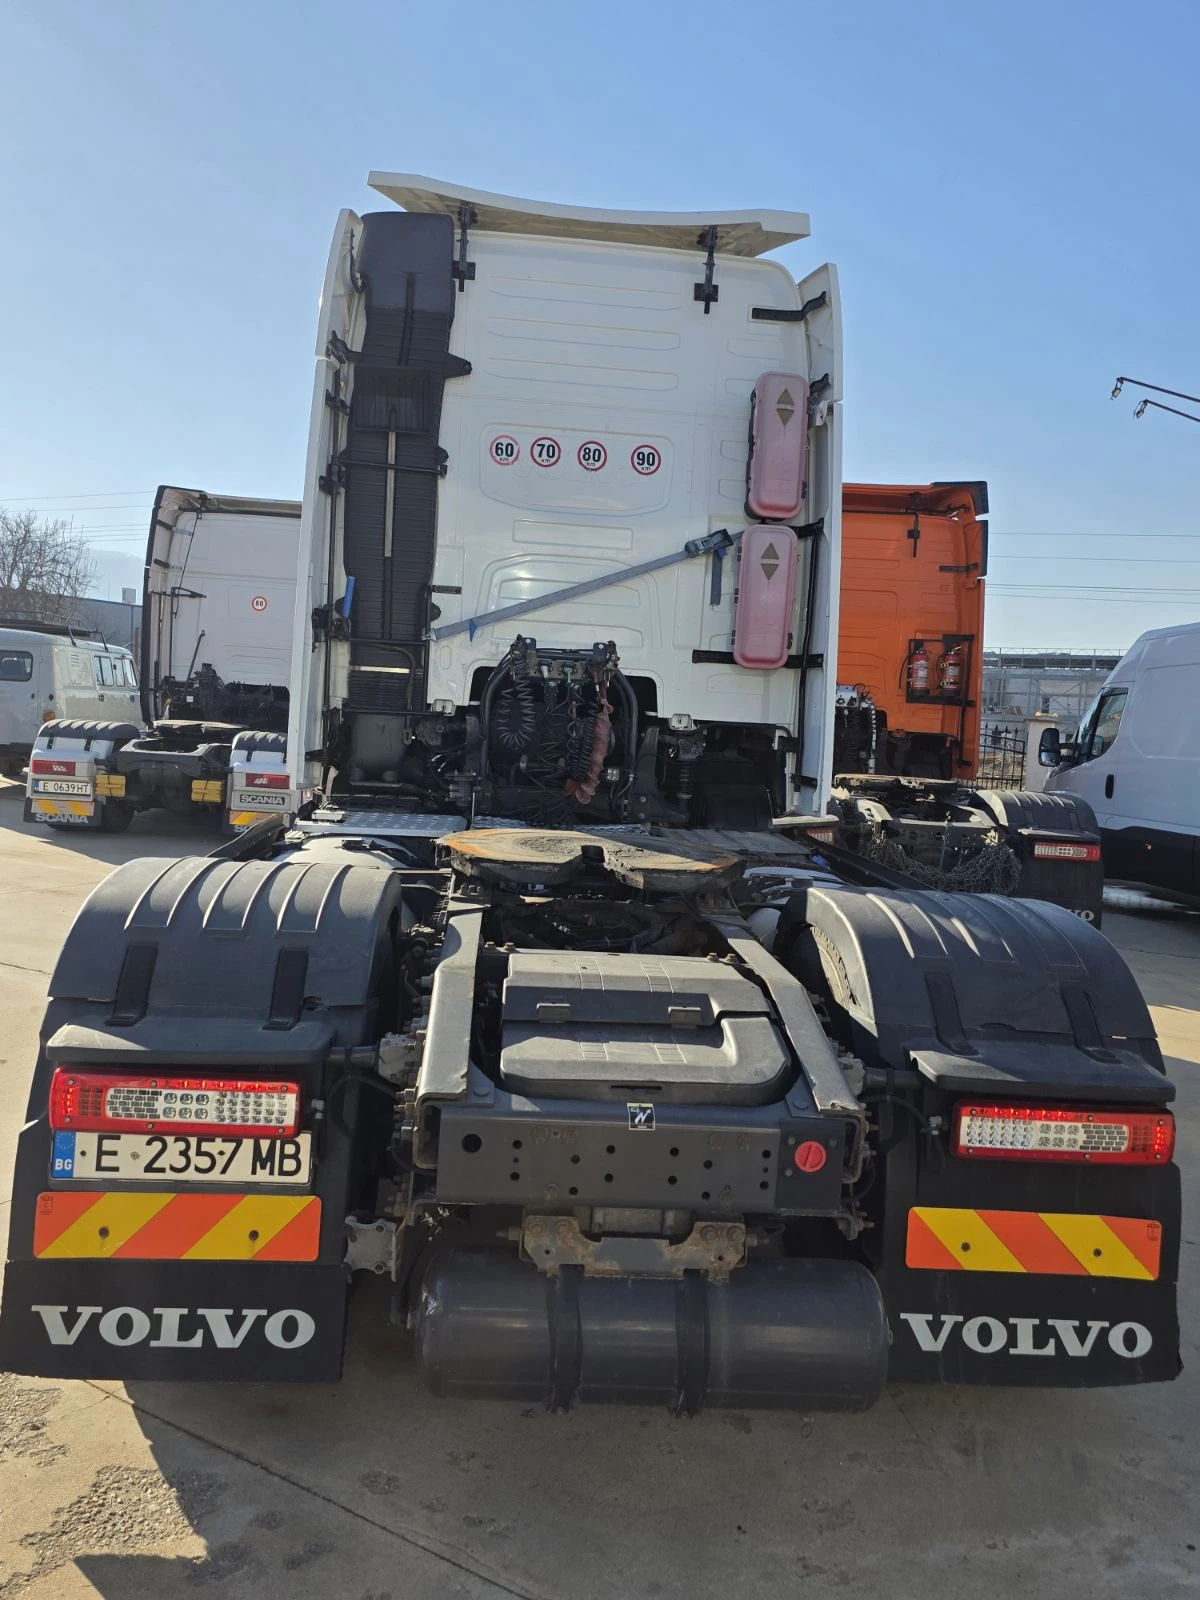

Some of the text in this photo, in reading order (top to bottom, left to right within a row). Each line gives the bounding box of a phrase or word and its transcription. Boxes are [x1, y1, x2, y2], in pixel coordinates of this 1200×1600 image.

[495, 441, 514, 457] 60
[537, 443, 556, 458] 70
[582, 447, 602, 462] 80
[636, 451, 656, 466] 90
[43, 782, 49, 791] E
[241, 795, 284, 805] SCANIA
[35, 813, 88, 824] SCANIA
[95, 1134, 303, 1177] E 2357 MB
[55, 1158, 73, 1170] BG
[31, 1304, 316, 1349] VOLVO
[900, 1312, 1153, 1358] VOLVO
